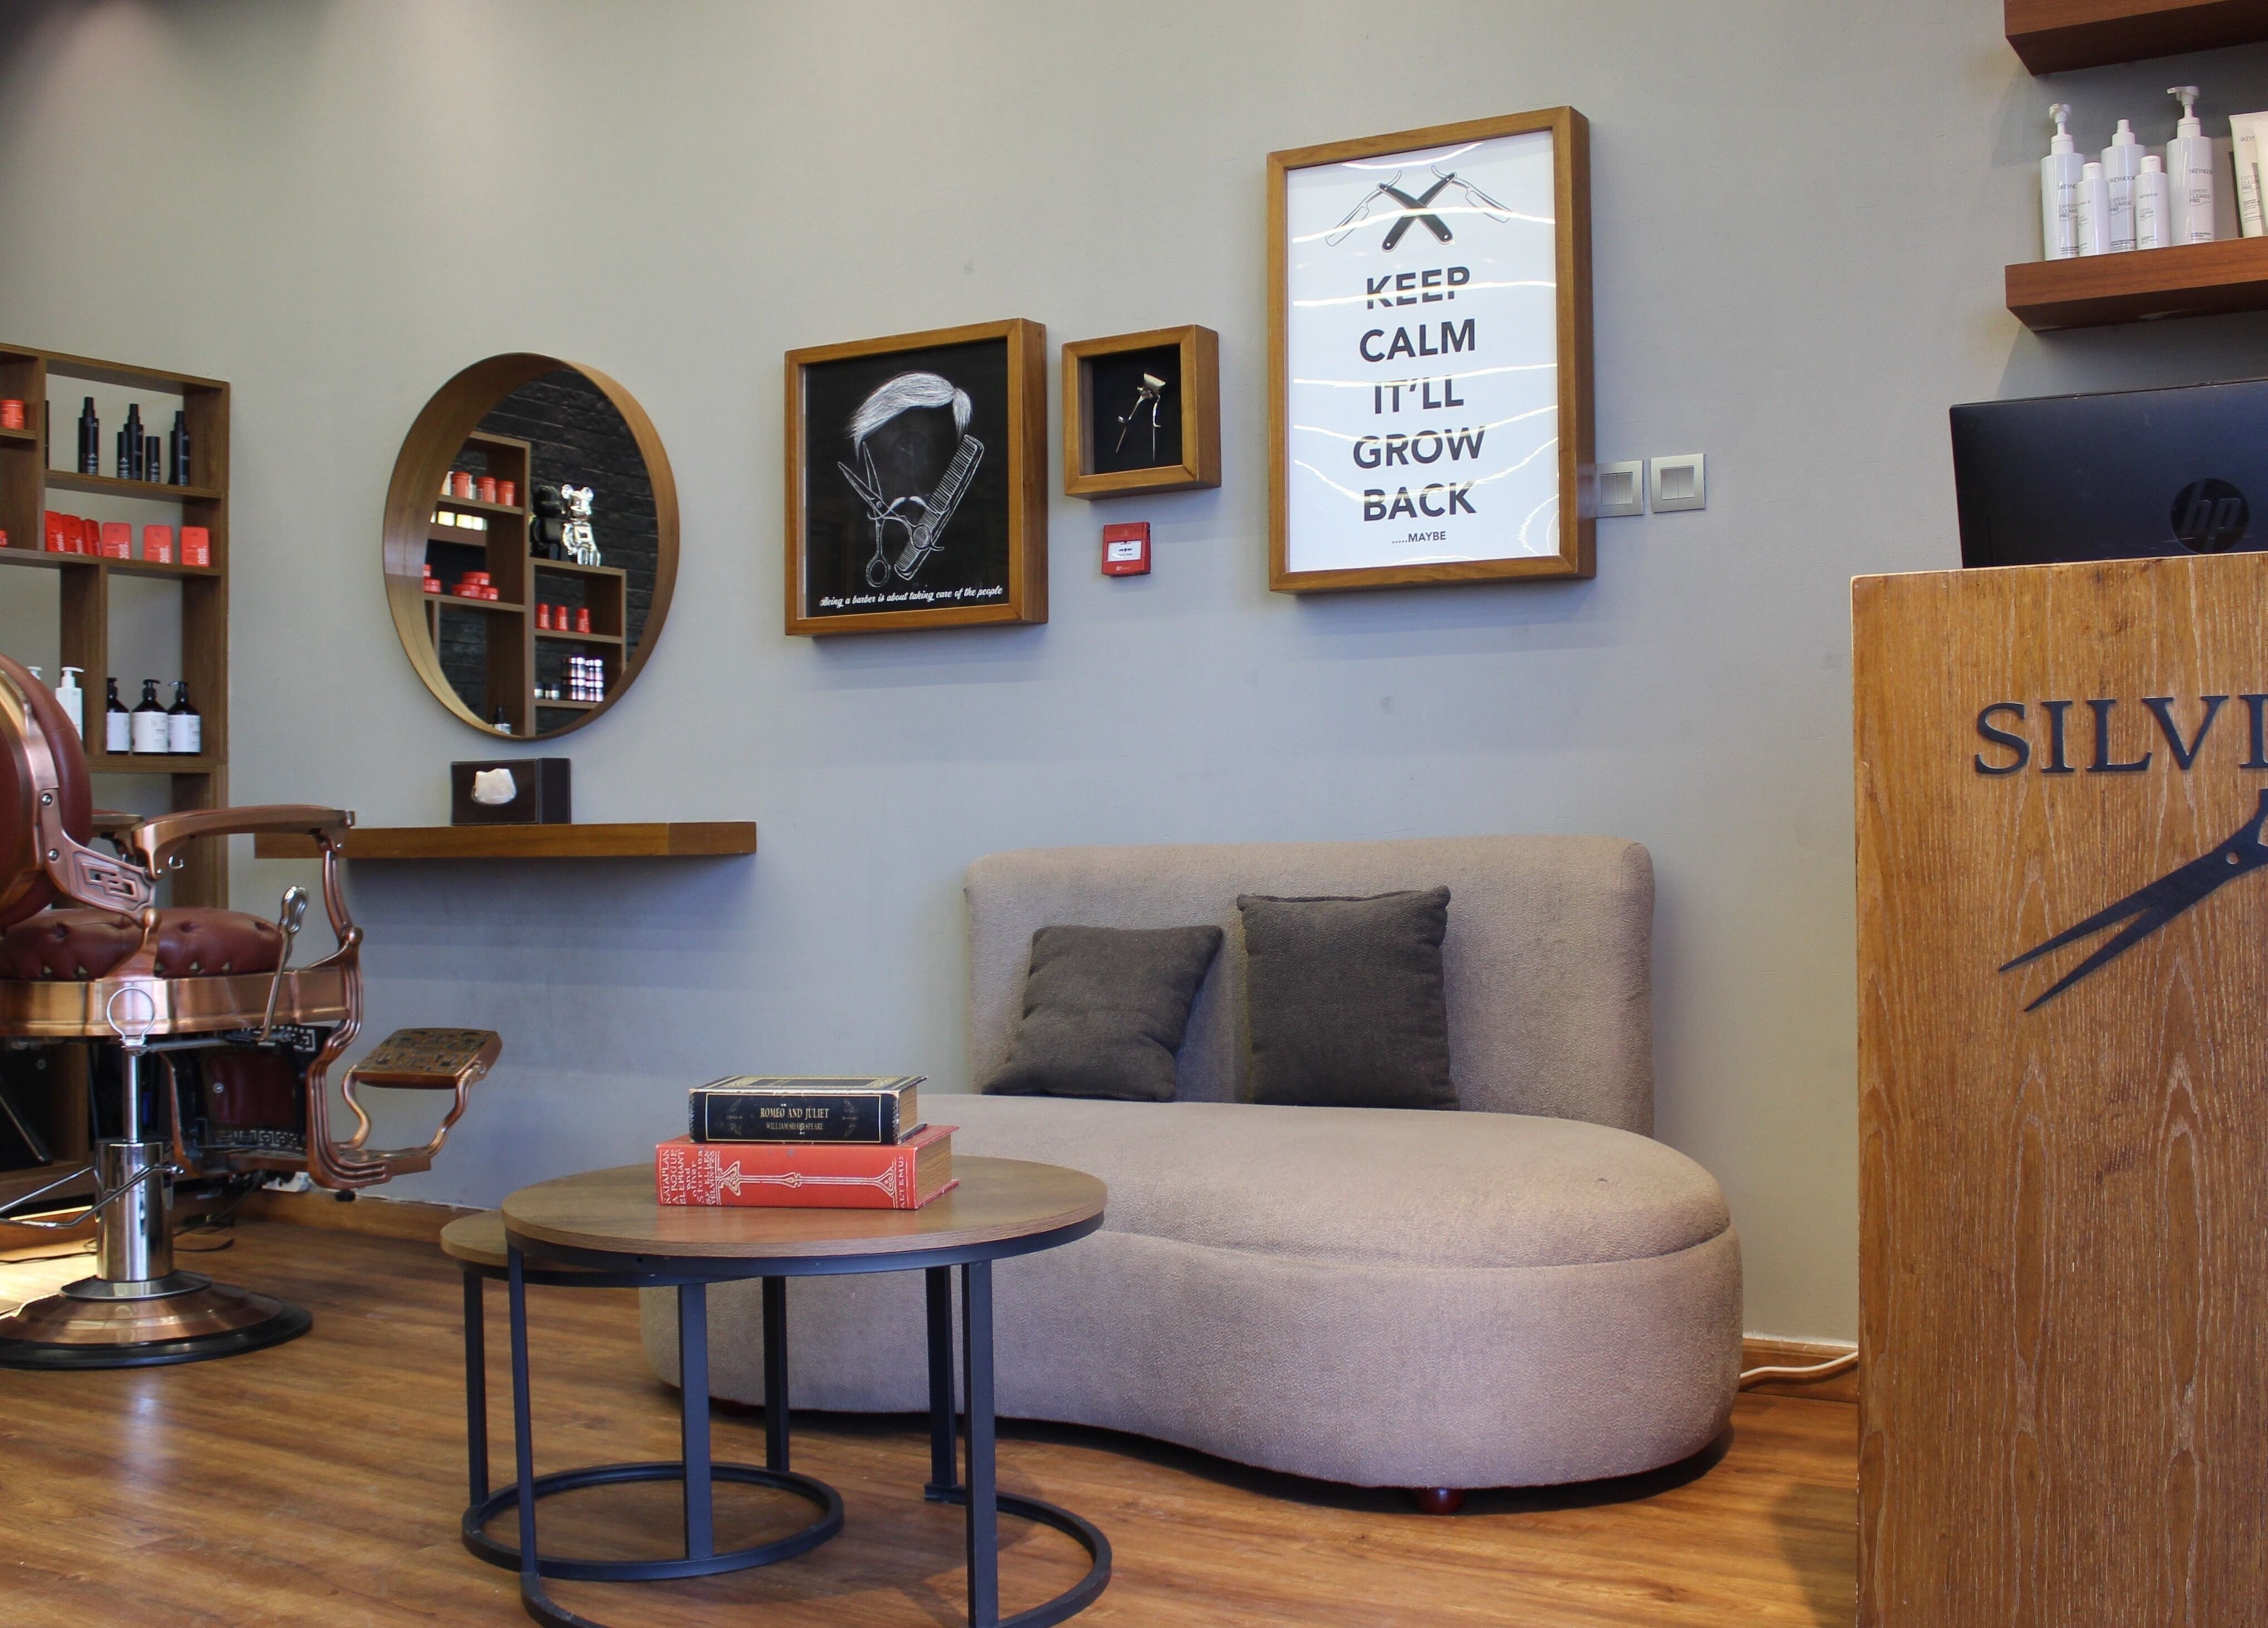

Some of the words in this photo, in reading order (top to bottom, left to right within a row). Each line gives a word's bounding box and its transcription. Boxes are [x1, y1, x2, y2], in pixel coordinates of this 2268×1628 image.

[1366, 266, 1470, 310] KEEP
[1360, 318, 1475, 363] CALM
[1374, 374, 1464, 415] IT'LL
[1353, 425, 1486, 469] GROW
[1363, 480, 1477, 522] BACK
[2181, 479, 2242, 554] hp
[820, 596, 844, 608] Being
[852, 595, 876, 604] barber
[878, 593, 885, 602] is
[887, 591, 908, 601] about
[909, 590, 935, 603] taking
[936, 590, 953, 598] care
[954, 588, 963, 600] of
[964, 587, 976, 597] the
[976, 585, 1003, 598] people
[1974, 693, 2268, 774] SILVI
[760, 1108, 785, 1118] ROMEO
[788, 1108, 803, 1118] AND
[804, 1108, 830, 1121] JULIET
[662, 1149, 671, 1204] KATAPLAN
[670, 1149, 678, 1191] ROGUE
[677, 1149, 686, 1204] ELEPHANT
[672, 1196, 679, 1204] A
